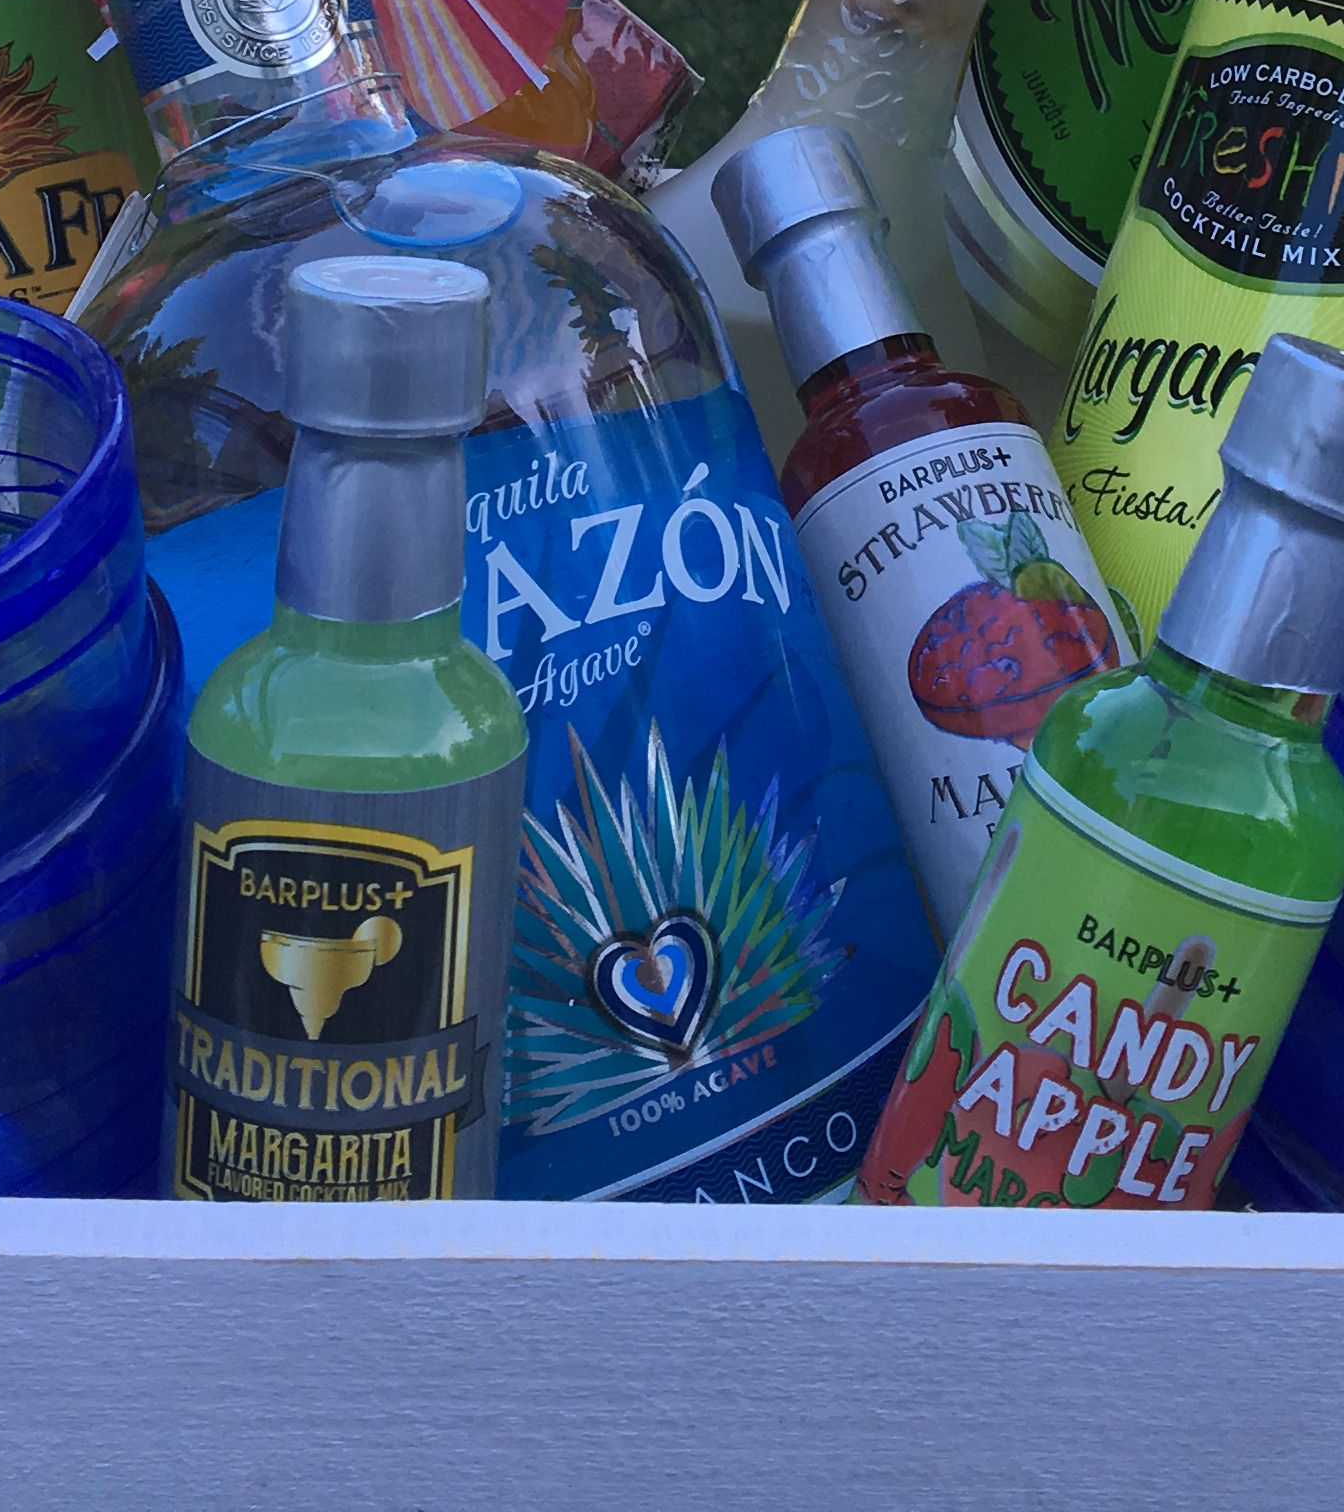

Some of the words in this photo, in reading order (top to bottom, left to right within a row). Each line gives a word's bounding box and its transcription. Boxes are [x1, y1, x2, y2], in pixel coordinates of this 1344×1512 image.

[221, 31, 293, 61] SINCE
[1209, 64, 1252, 89] LOW
[1228, 90, 1271, 106] Fresh
[1162, 177, 1267, 259] COCKTAIL
[1201, 190, 1255, 224] Better
[465, 449, 590, 544] quila
[1082, 465, 1223, 530] Fiesta!
[485, 461, 791, 662] AZÓN
[176, 1012, 468, 1112] TRADITIONAL
[995, 938, 1260, 1114] CANDY
[608, 1090, 687, 1138] 100%
[692, 1044, 780, 1104] AGAVE
[956, 1040, 1216, 1204] APPLE
[207, 1163, 284, 1202] FLAVORED
[208, 1109, 415, 1184] MARGARITA
